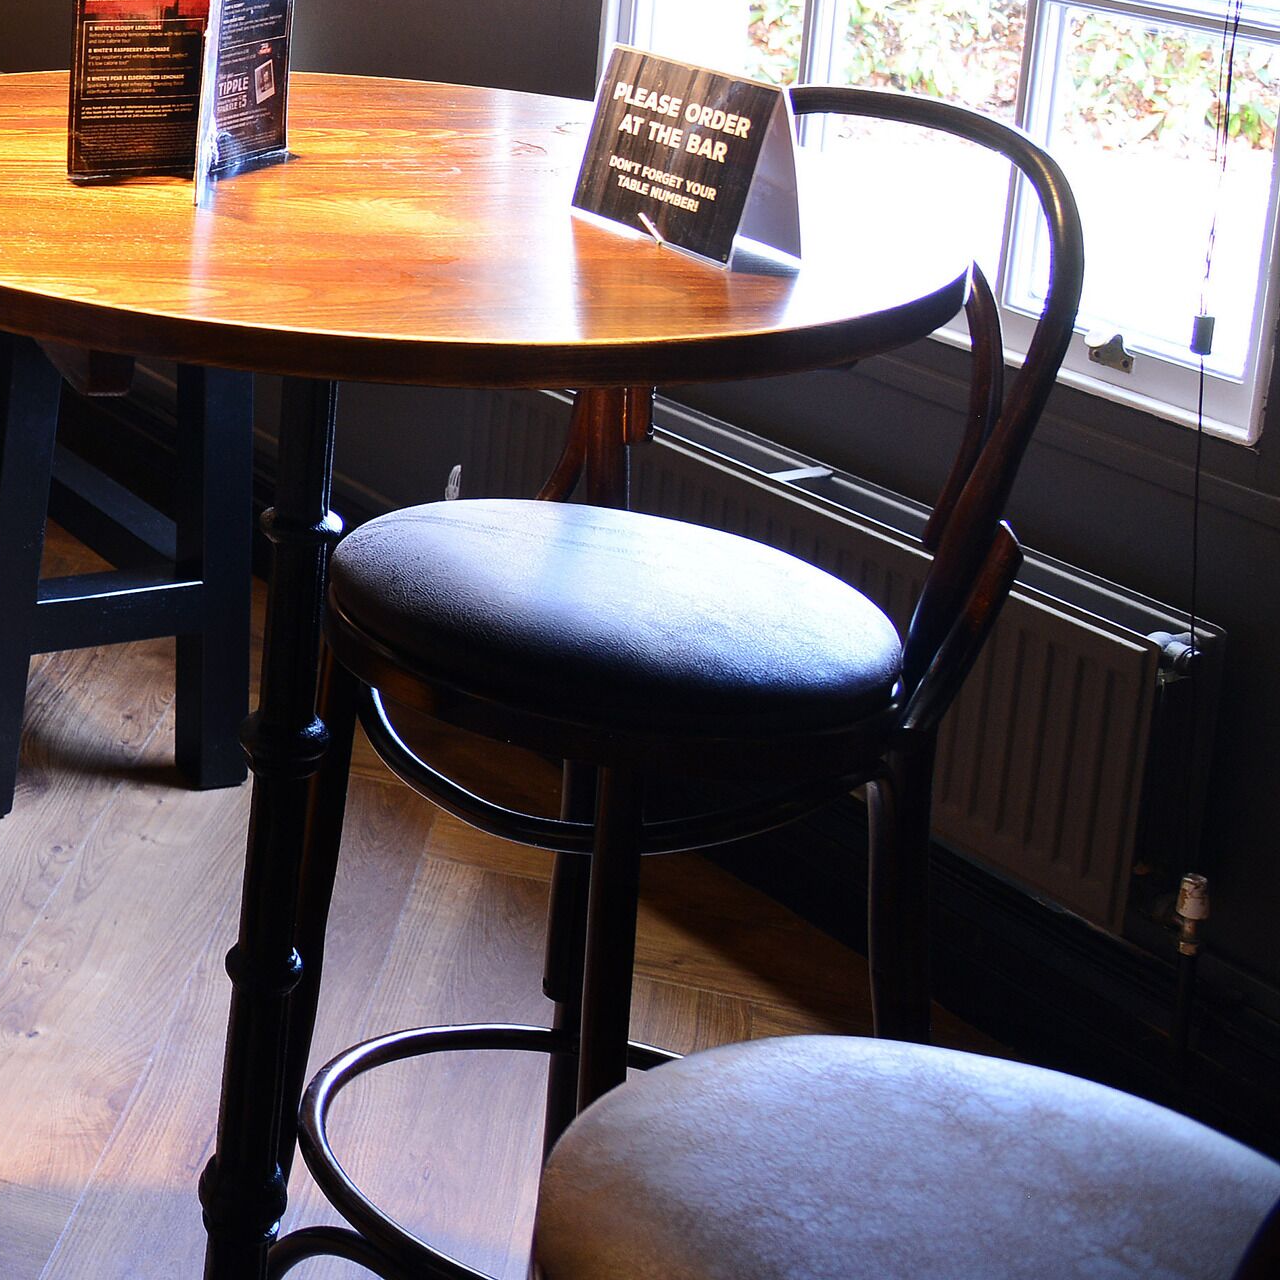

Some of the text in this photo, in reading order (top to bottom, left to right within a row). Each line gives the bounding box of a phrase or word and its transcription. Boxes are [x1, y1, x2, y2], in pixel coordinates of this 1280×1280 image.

[218, 76, 249, 97] TIPPLE
[612, 81, 752, 139] PLEASE ORDER
[618, 113, 729, 163] AT THE BAR
[609, 154, 717, 201] DON'T FORGET YOUR
[617, 174, 700, 213] TABLE NUMBER!
